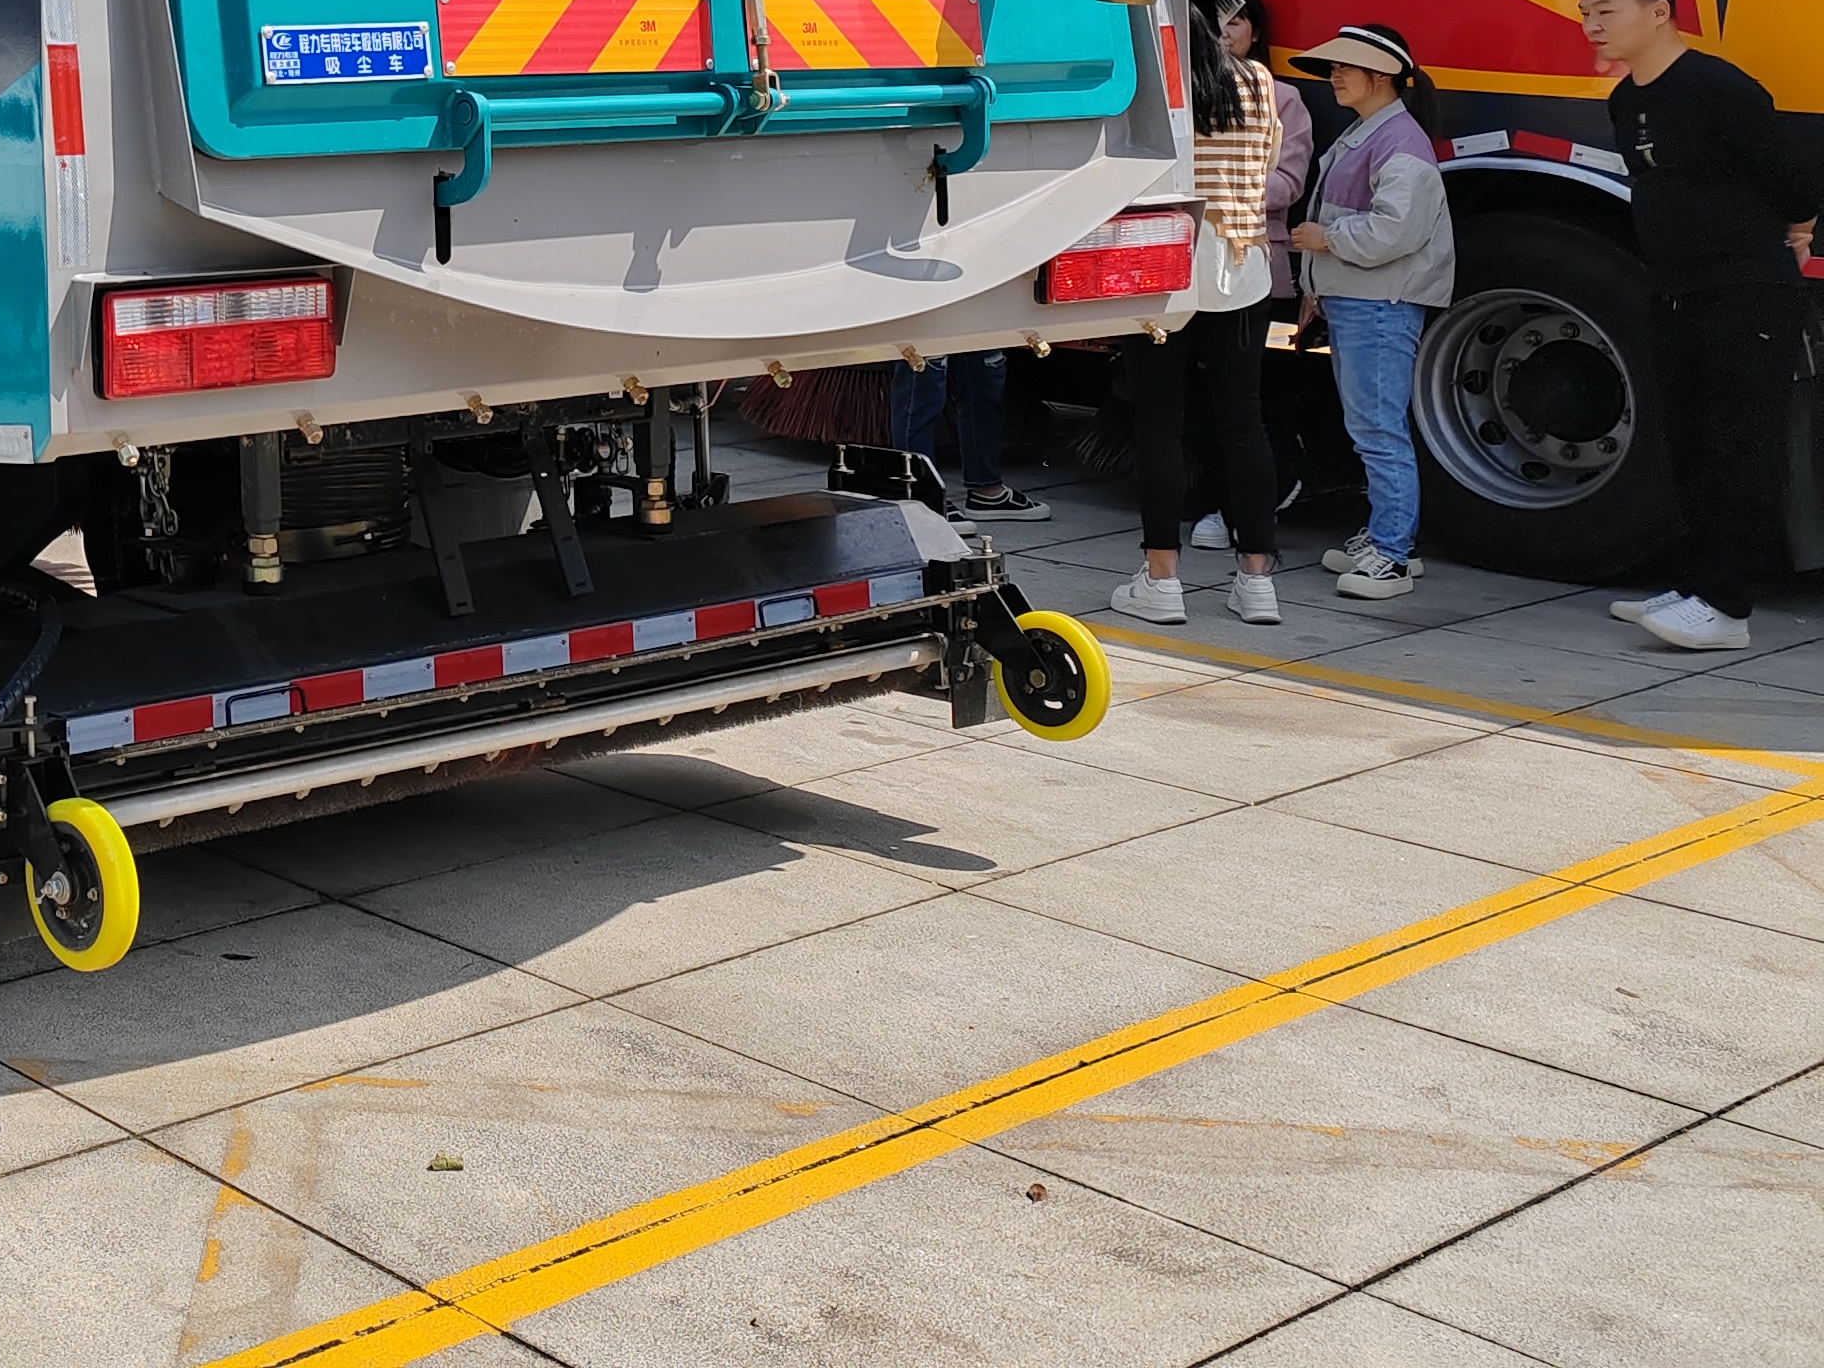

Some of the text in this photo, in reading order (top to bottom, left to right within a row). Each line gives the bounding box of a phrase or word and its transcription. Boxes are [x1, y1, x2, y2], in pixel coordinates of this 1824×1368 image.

[640, 20, 657, 33] 3M
[802, 22, 818, 34] 3M
[298, 30, 424, 54] 程力专用汽车股份有限公司
[324, 53, 404, 75] 吸尘车
